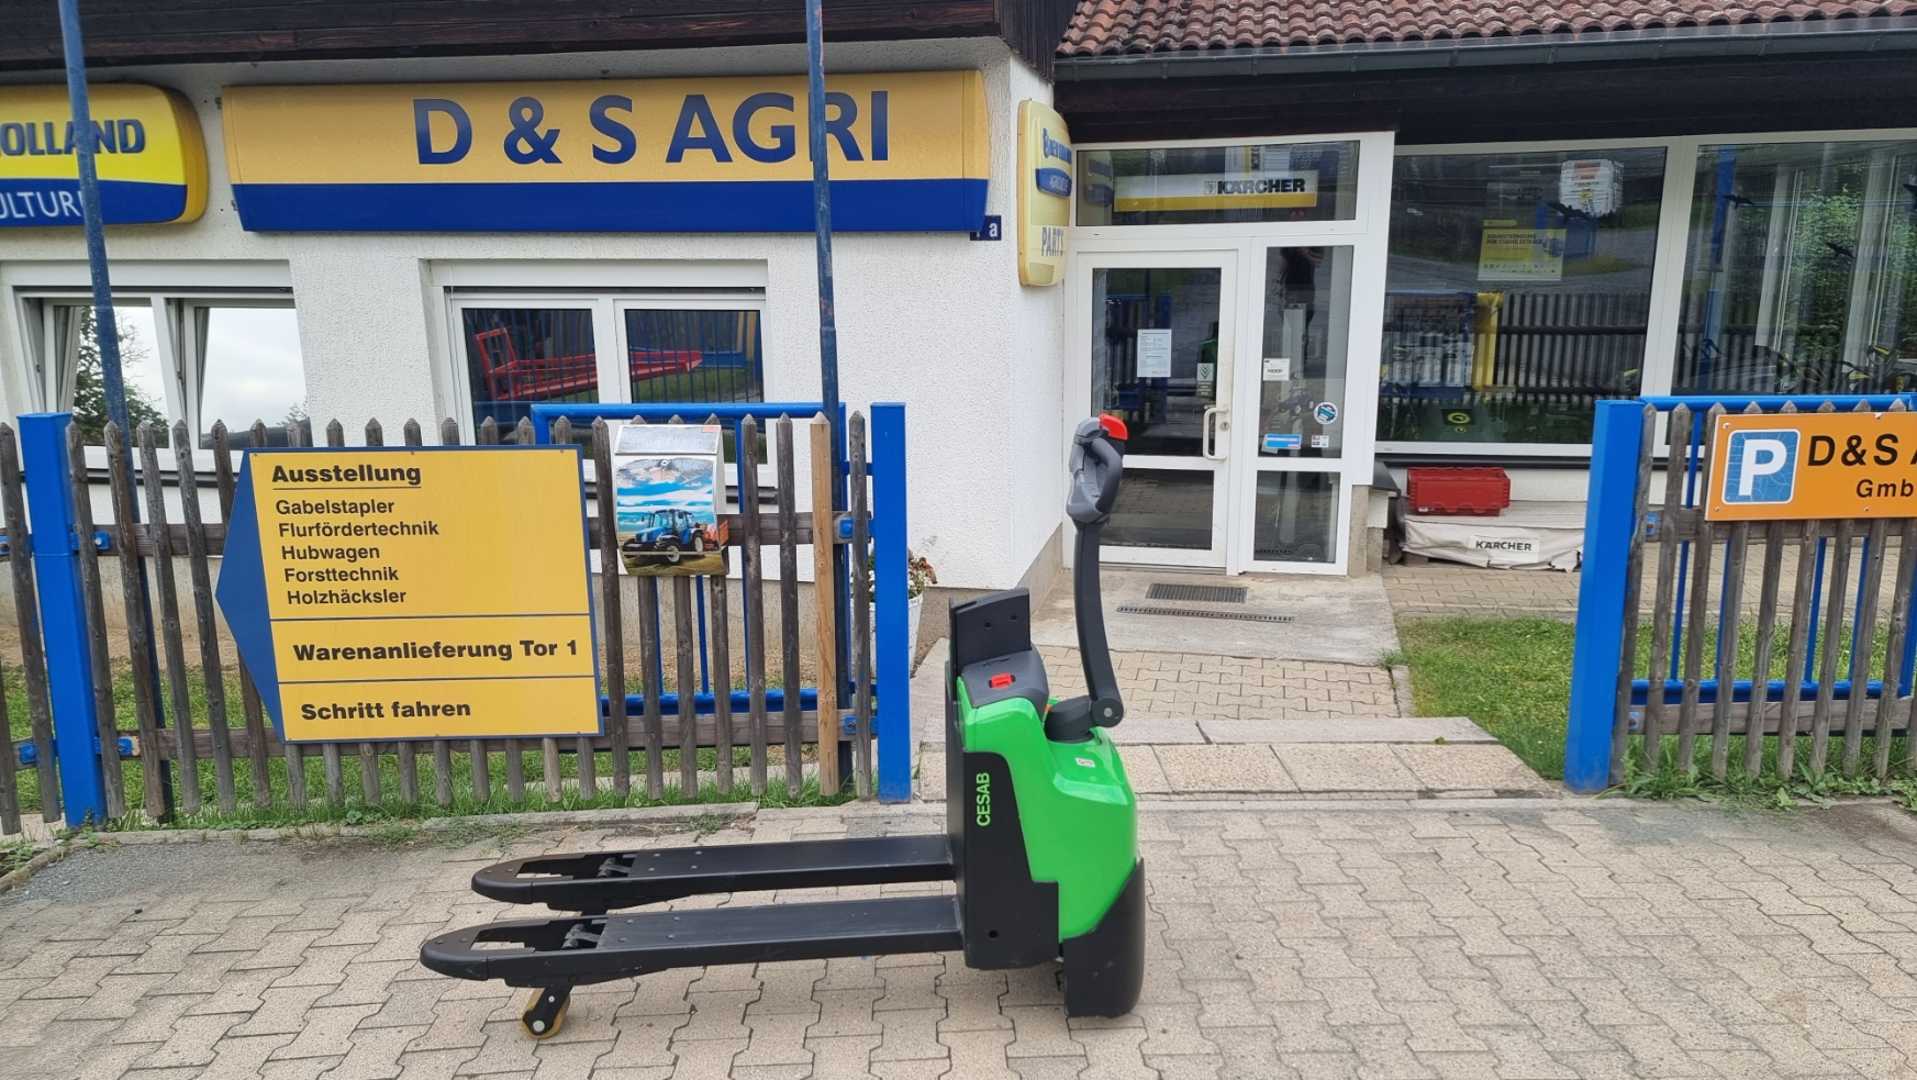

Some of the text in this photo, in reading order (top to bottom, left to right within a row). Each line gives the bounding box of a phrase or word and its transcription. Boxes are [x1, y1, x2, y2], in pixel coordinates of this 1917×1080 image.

[413, 90, 889, 164] D & S AGRI
[271, 464, 422, 486] Ausstellung
[1738, 439, 1787, 496] P
[1808, 434, 1899, 466] D&S
[1856, 479, 1914, 498] Gmb
[275, 498, 395, 518] Gabelstapler
[278, 520, 440, 538] Flurfördertechnik
[281, 544, 380, 563] Hubwagen
[284, 566, 399, 583] Forsttechnik
[287, 588, 407, 605] Holzhäcksler
[293, 639, 577, 662] Warenanlieferung Tor 1
[300, 700, 471, 721] Schritt fahren
[976, 772, 991, 826] CESAB
